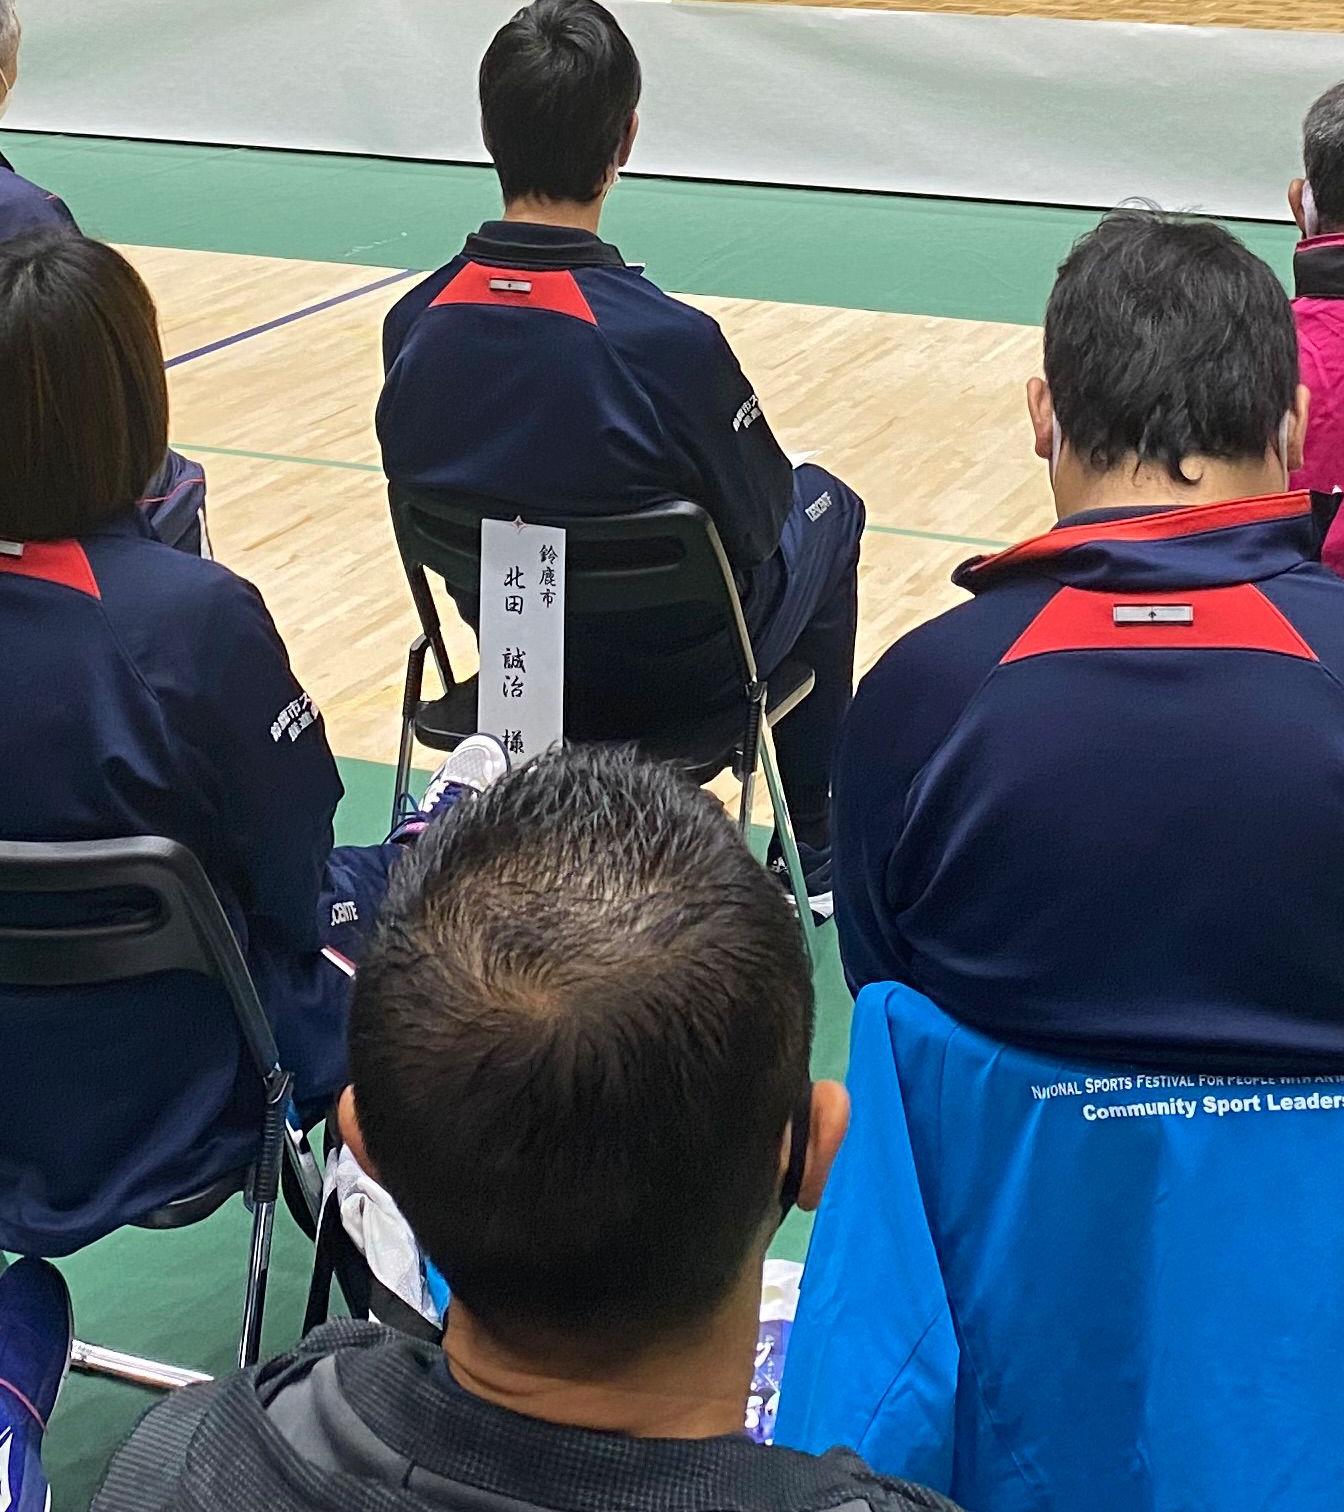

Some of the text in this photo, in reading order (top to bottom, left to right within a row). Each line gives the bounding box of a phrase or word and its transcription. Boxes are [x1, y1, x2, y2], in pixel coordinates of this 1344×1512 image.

[504, 566, 525, 615] 北田
[539, 544, 558, 608] 鈴鹿市
[1085, 1077, 1132, 1094] SPORTS
[1136, 1074, 1194, 1088] FESTIVAL
[1199, 1075, 1224, 1086] FOR
[1083, 1097, 1197, 1121] Community
[1203, 1093, 1261, 1116] Sport
